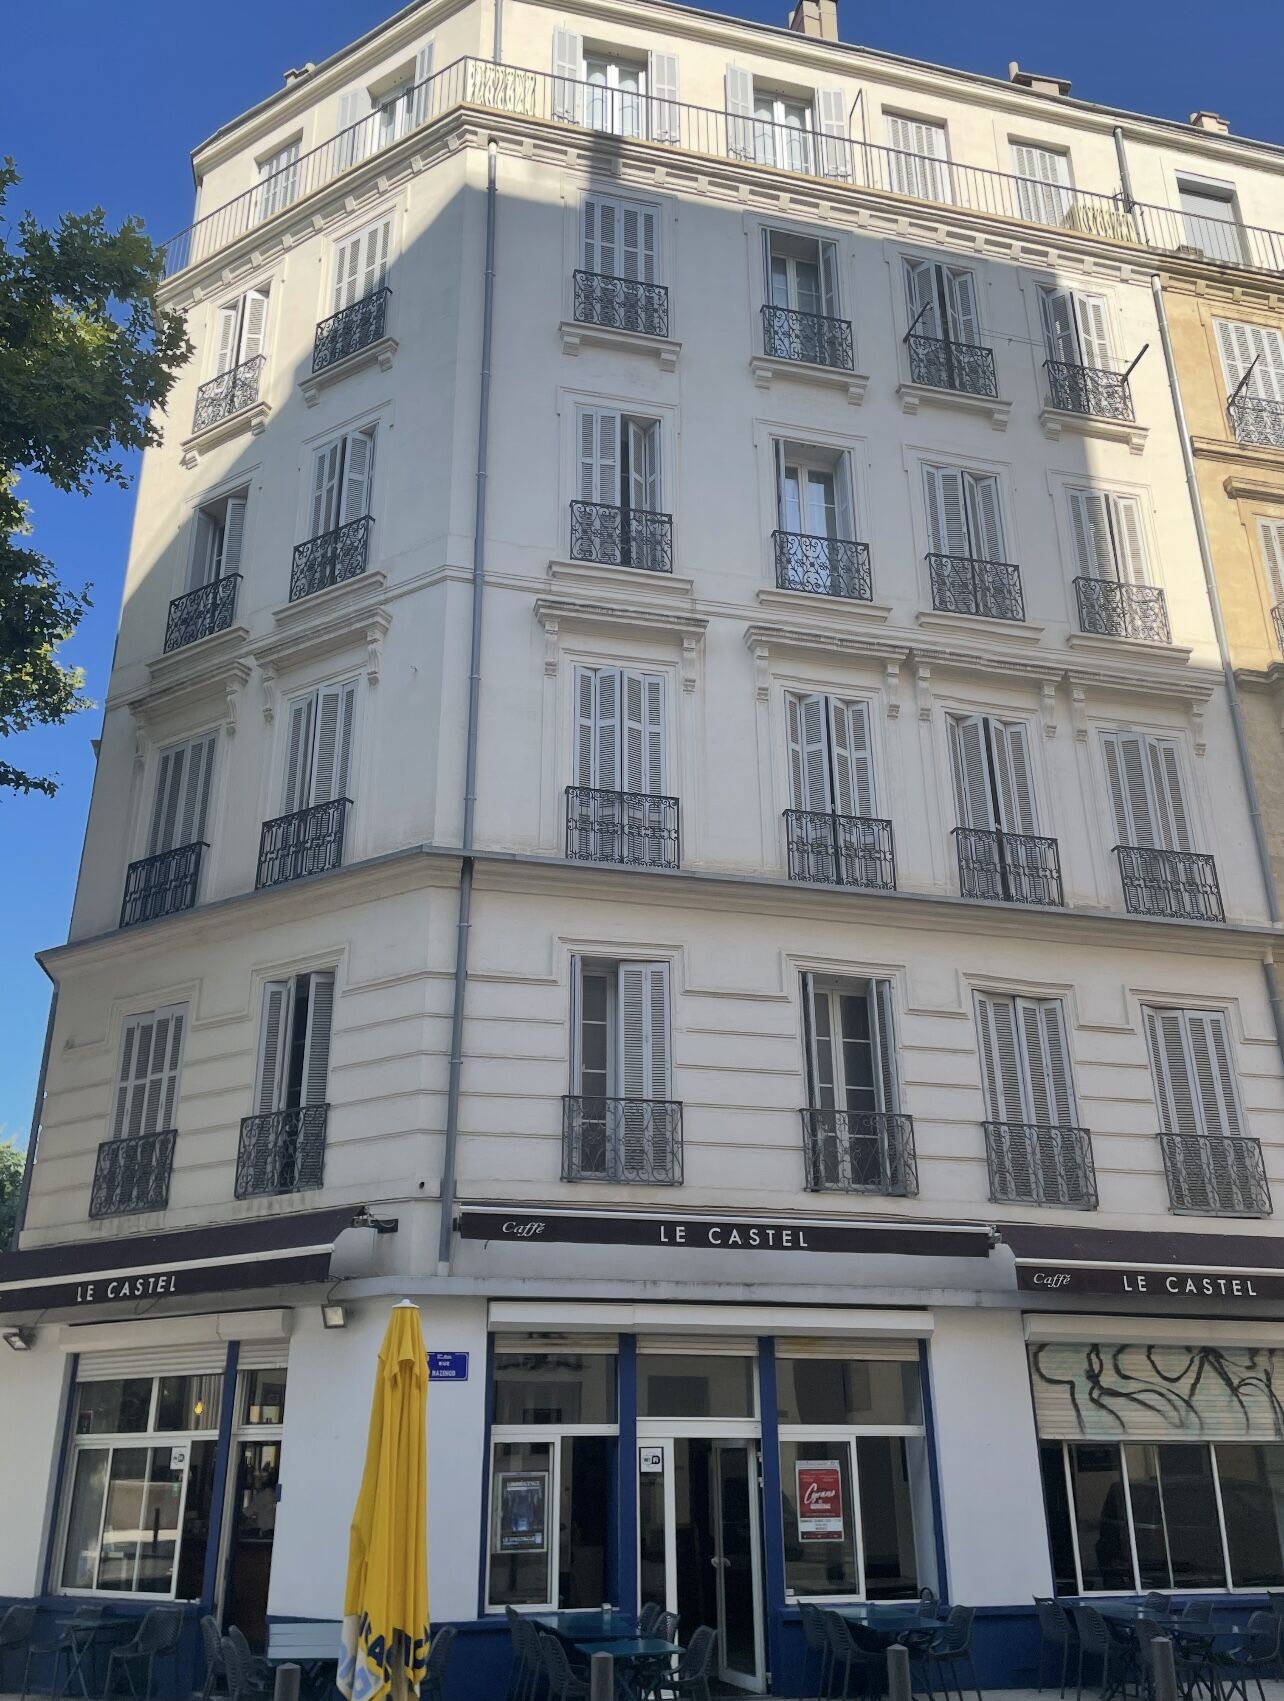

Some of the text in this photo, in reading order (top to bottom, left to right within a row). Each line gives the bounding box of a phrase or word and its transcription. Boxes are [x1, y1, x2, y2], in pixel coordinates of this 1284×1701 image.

[660, 1225, 808, 1247] LE CASTEL
[77, 1275, 176, 1301] LE CASTEL
[1123, 1275, 1256, 1296] LE CASTEL
